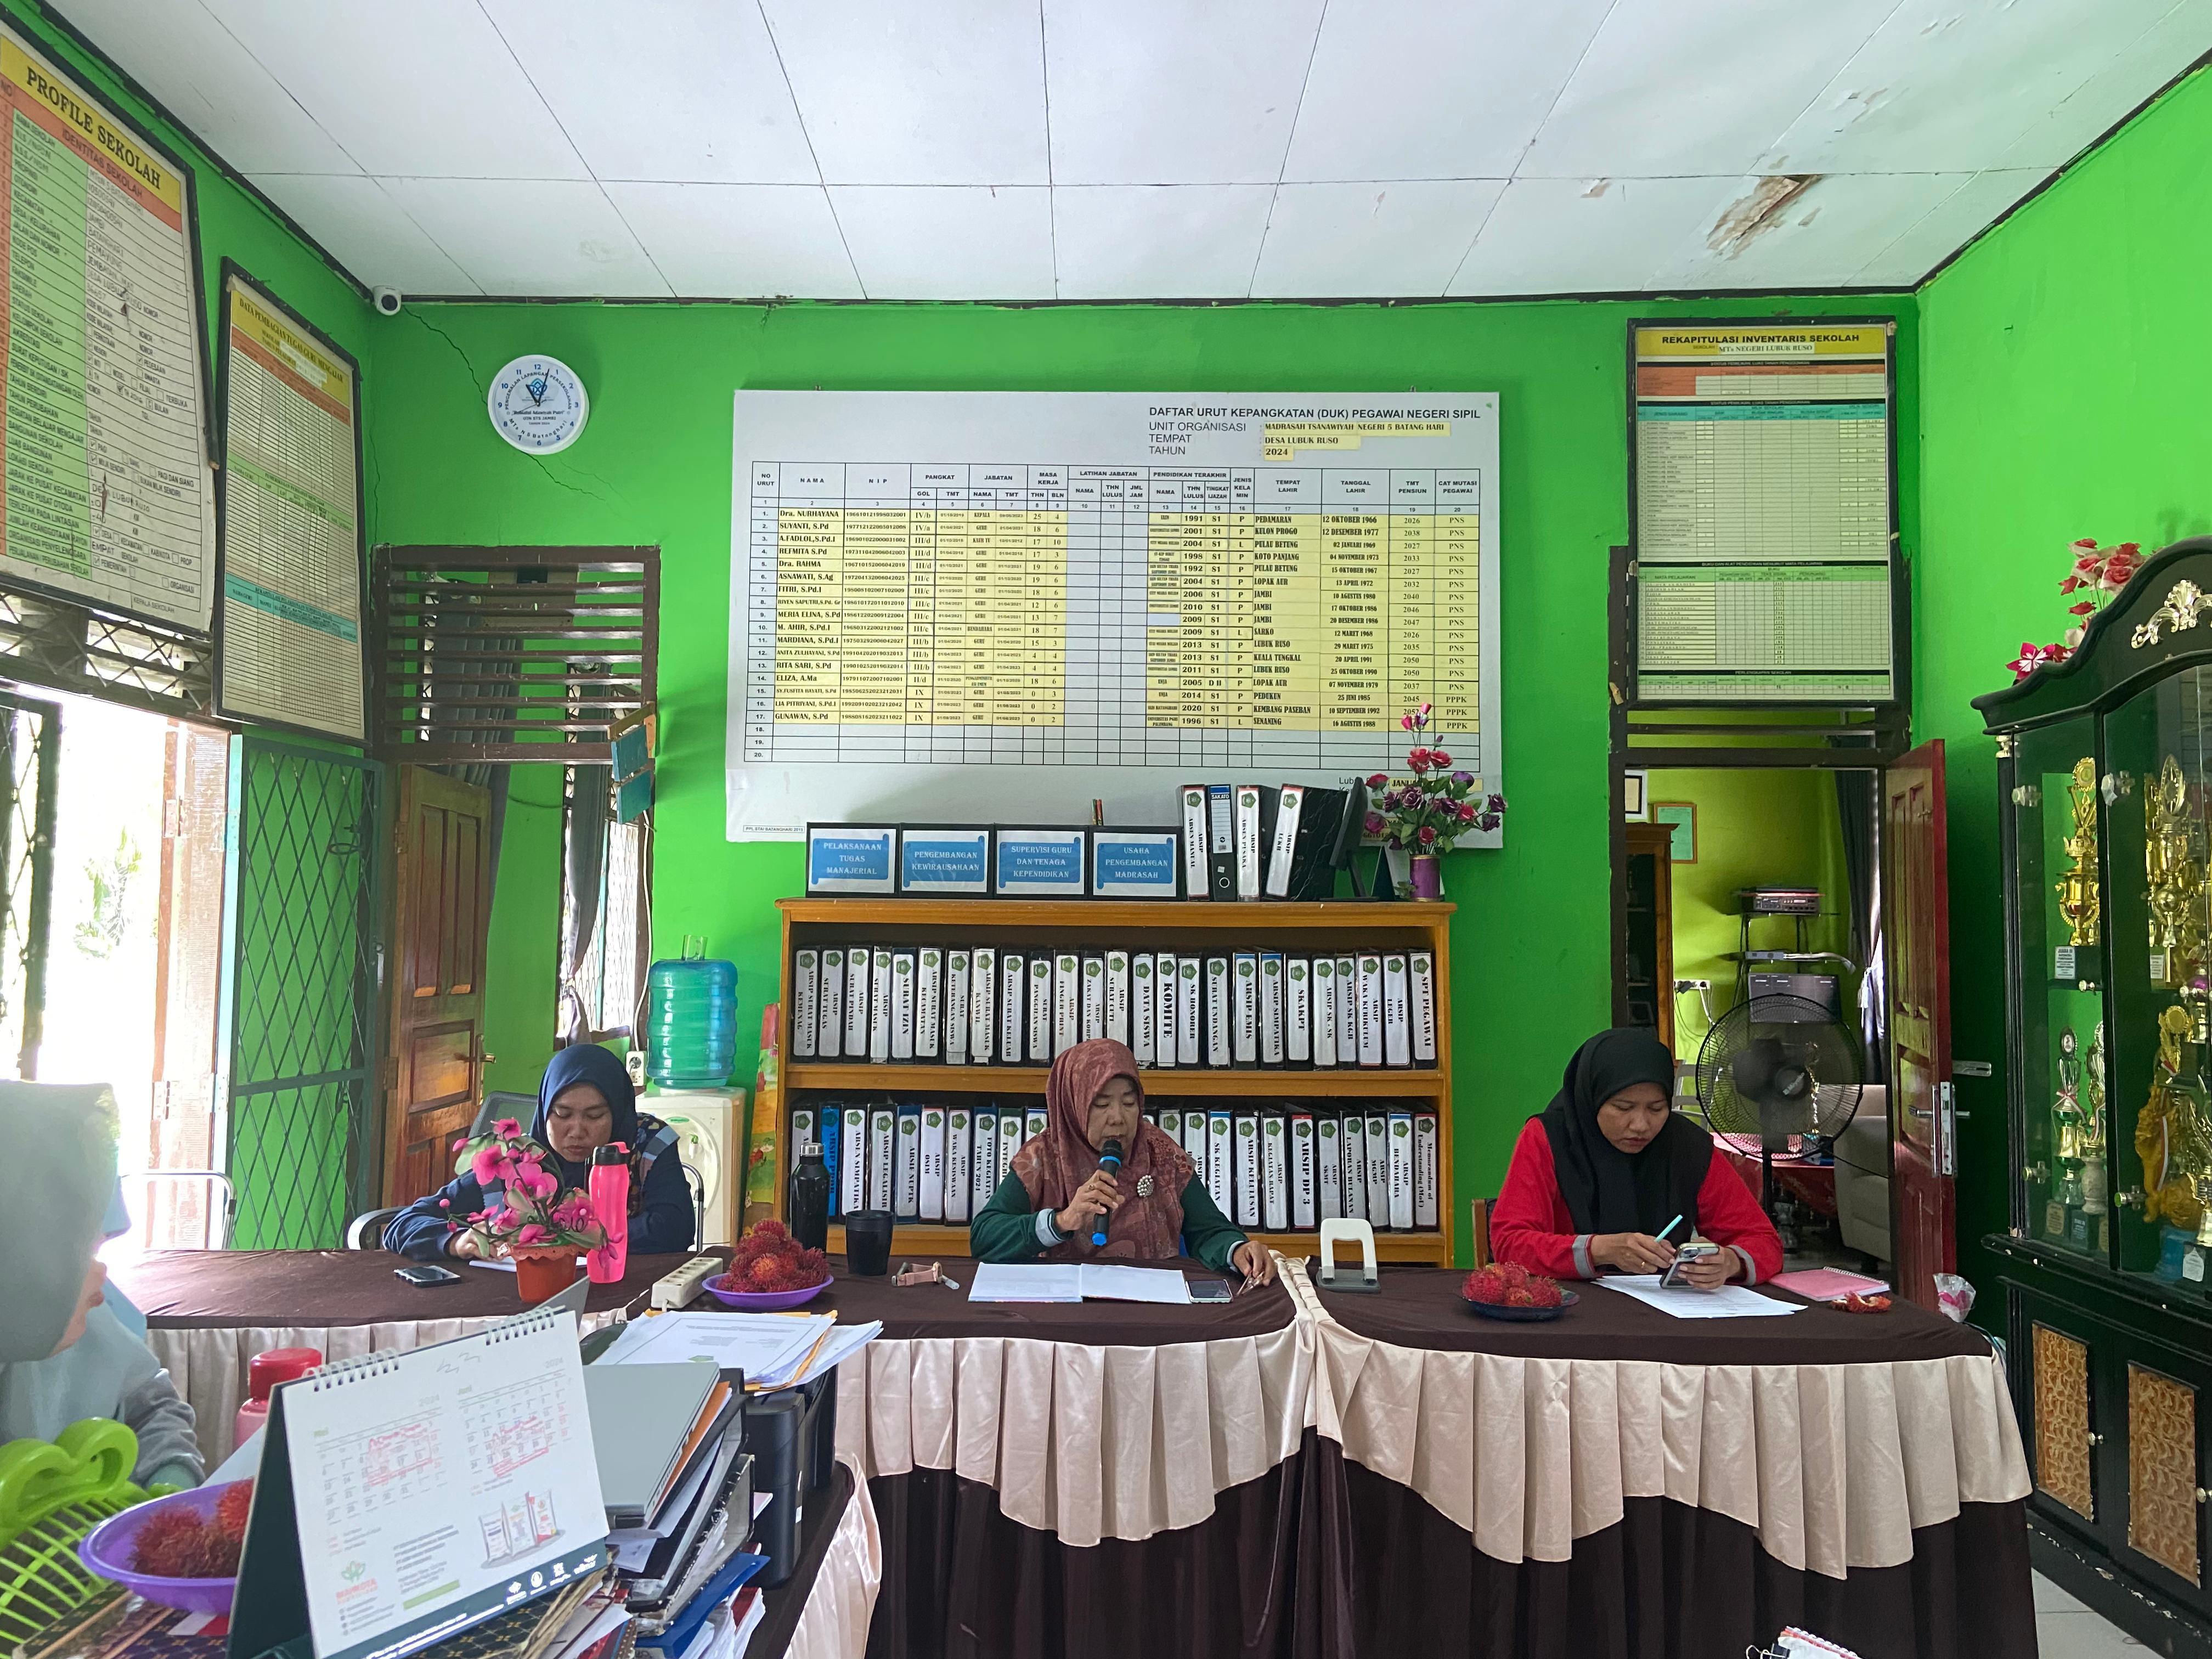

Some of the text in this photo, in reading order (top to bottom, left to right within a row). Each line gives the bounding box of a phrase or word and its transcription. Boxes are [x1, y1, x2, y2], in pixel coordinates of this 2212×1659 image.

[27, 66, 160, 189] PROFILE SEKOLAH
[63, 128, 142, 198] IDENTITAS SEKOLAH
[240, 298, 253, 316] DATA
[255, 311, 286, 339] PEMBAGIAN
[286, 334, 303, 353] TUGAS
[304, 348, 317, 364] GURU
[1150, 408, 1194, 416] DAFTAR
[1198, 408, 1227, 417] URUT
[1318, 409, 1348, 419] (DUK)
[1352, 410, 1403, 418] PEGAWAI
[1408, 410, 1449, 418] NEGERI
[1178, 422, 1246, 431] ORGANISASI
[1164, 983, 1172, 1038] KOMITE
[1302, 1180, 1310, 1195] DP
